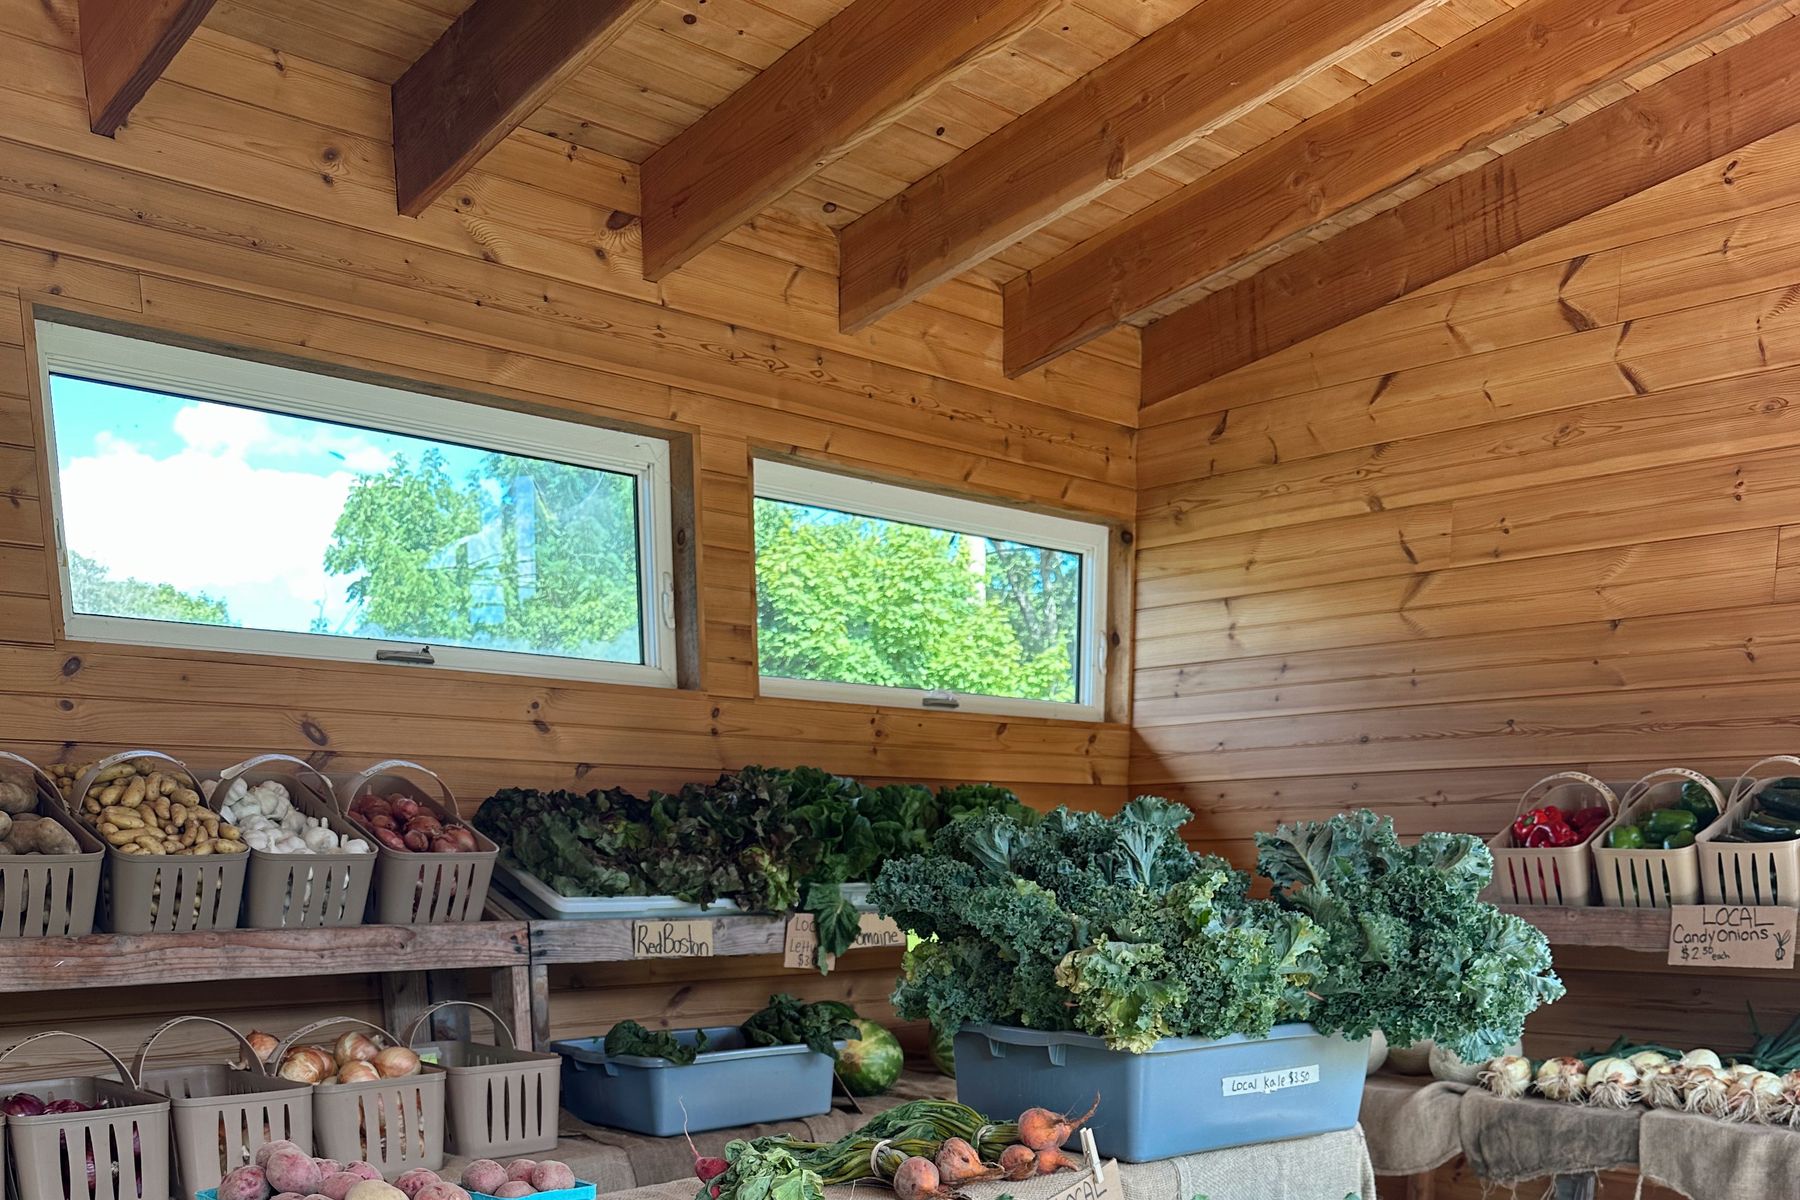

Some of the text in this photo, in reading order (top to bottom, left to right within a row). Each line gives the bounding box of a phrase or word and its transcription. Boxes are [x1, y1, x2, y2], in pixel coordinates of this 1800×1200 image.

[1702, 906, 1775, 928] LOCAL
[855, 930, 899, 947] omaine
[1711, 952, 1730, 961] each
